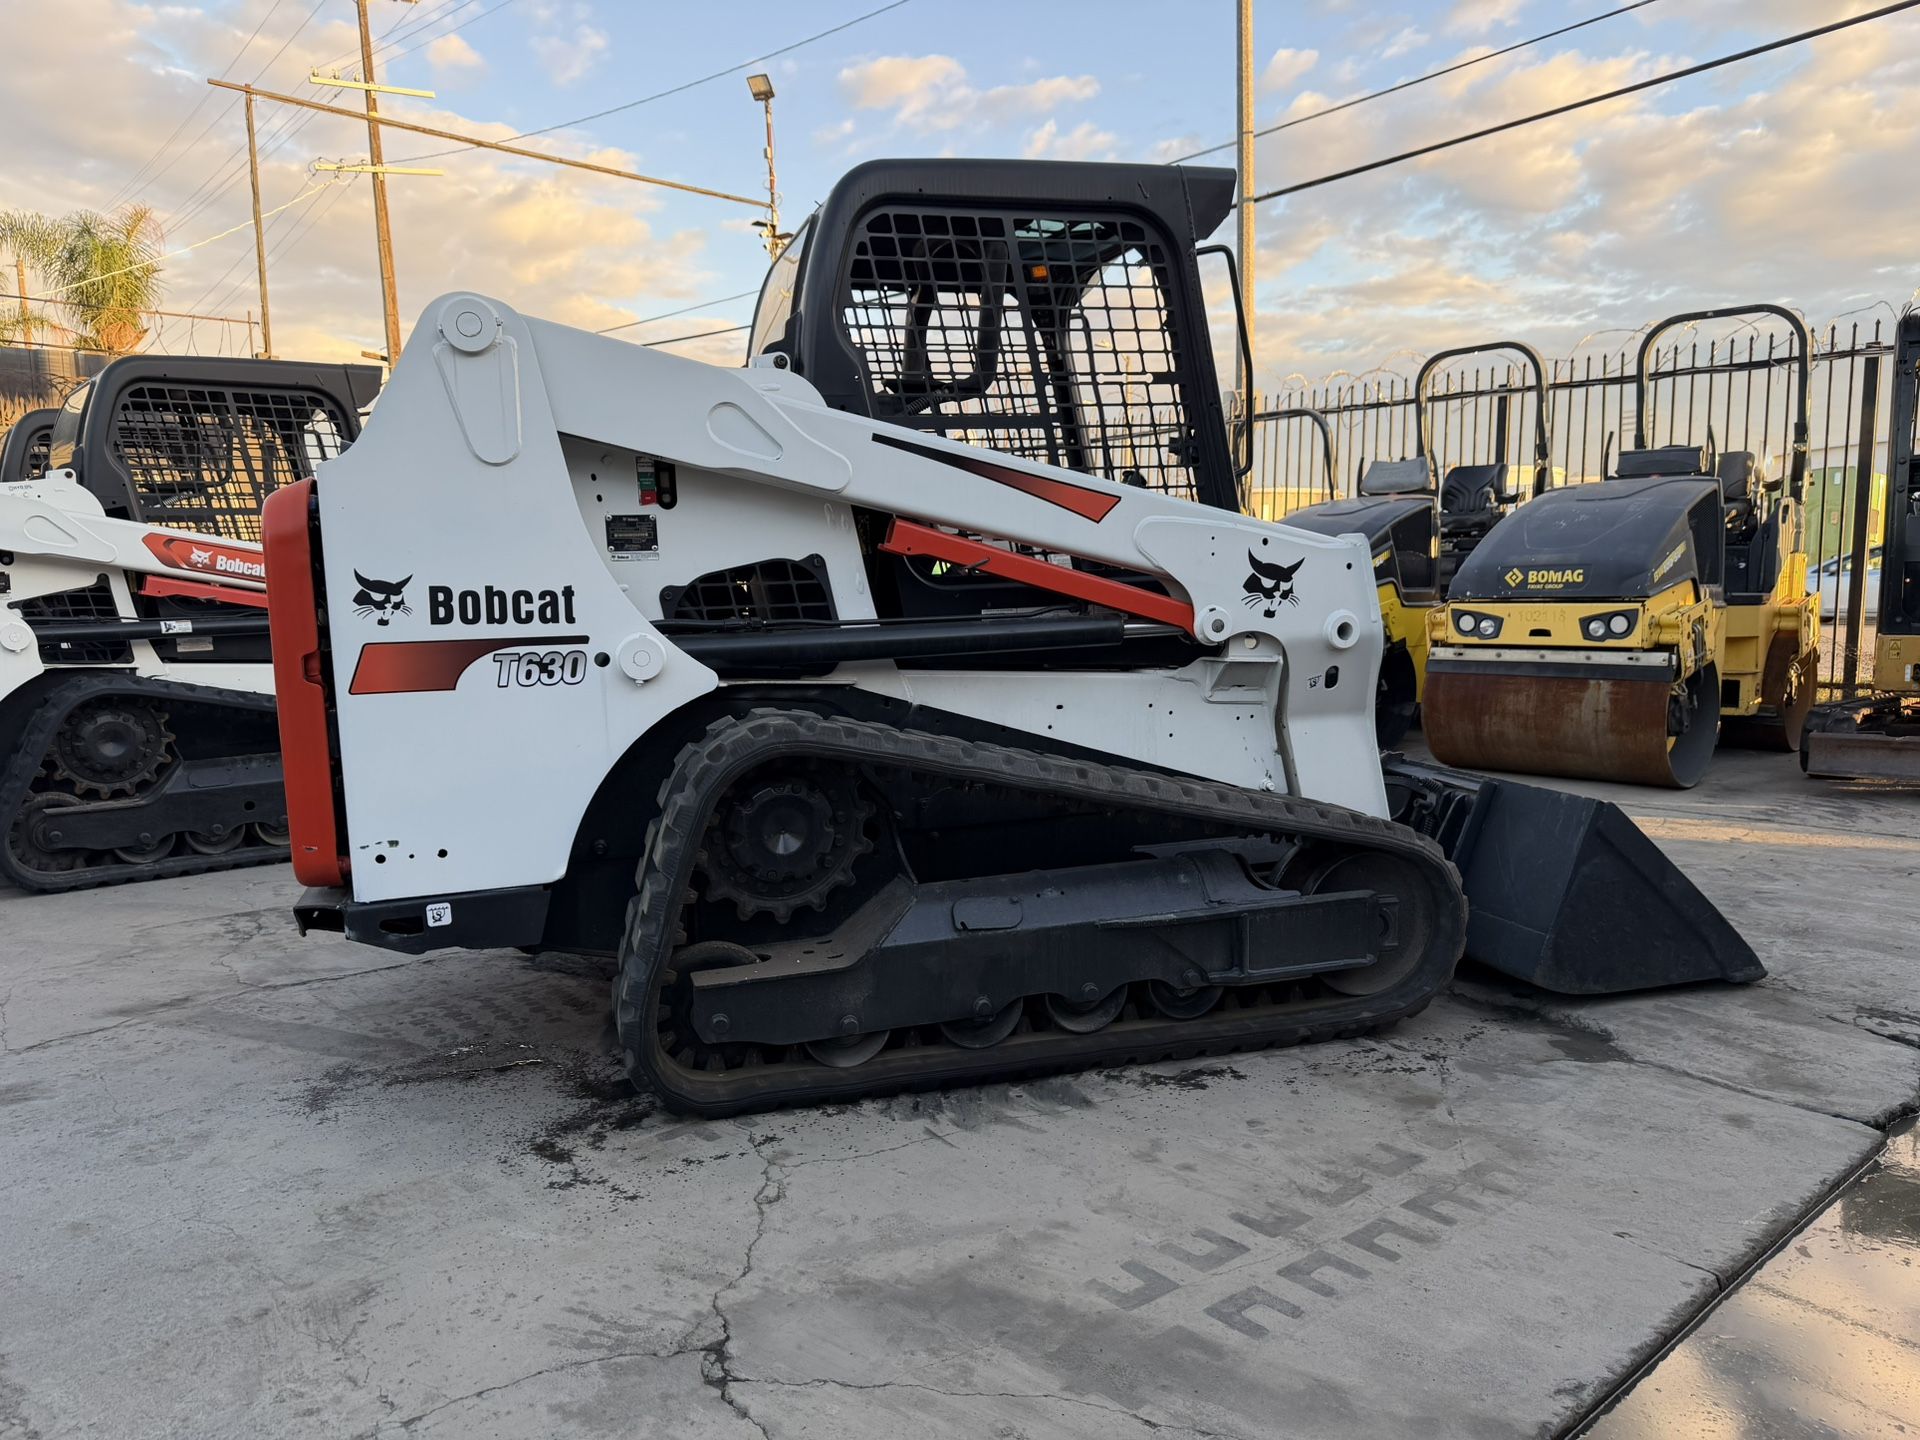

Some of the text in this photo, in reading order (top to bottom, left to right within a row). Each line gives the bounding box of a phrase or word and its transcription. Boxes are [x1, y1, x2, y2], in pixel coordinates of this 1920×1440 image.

[1527, 569, 1584, 583] BOMAG
[428, 585, 576, 625] Bobcat
[493, 650, 587, 688] T630
